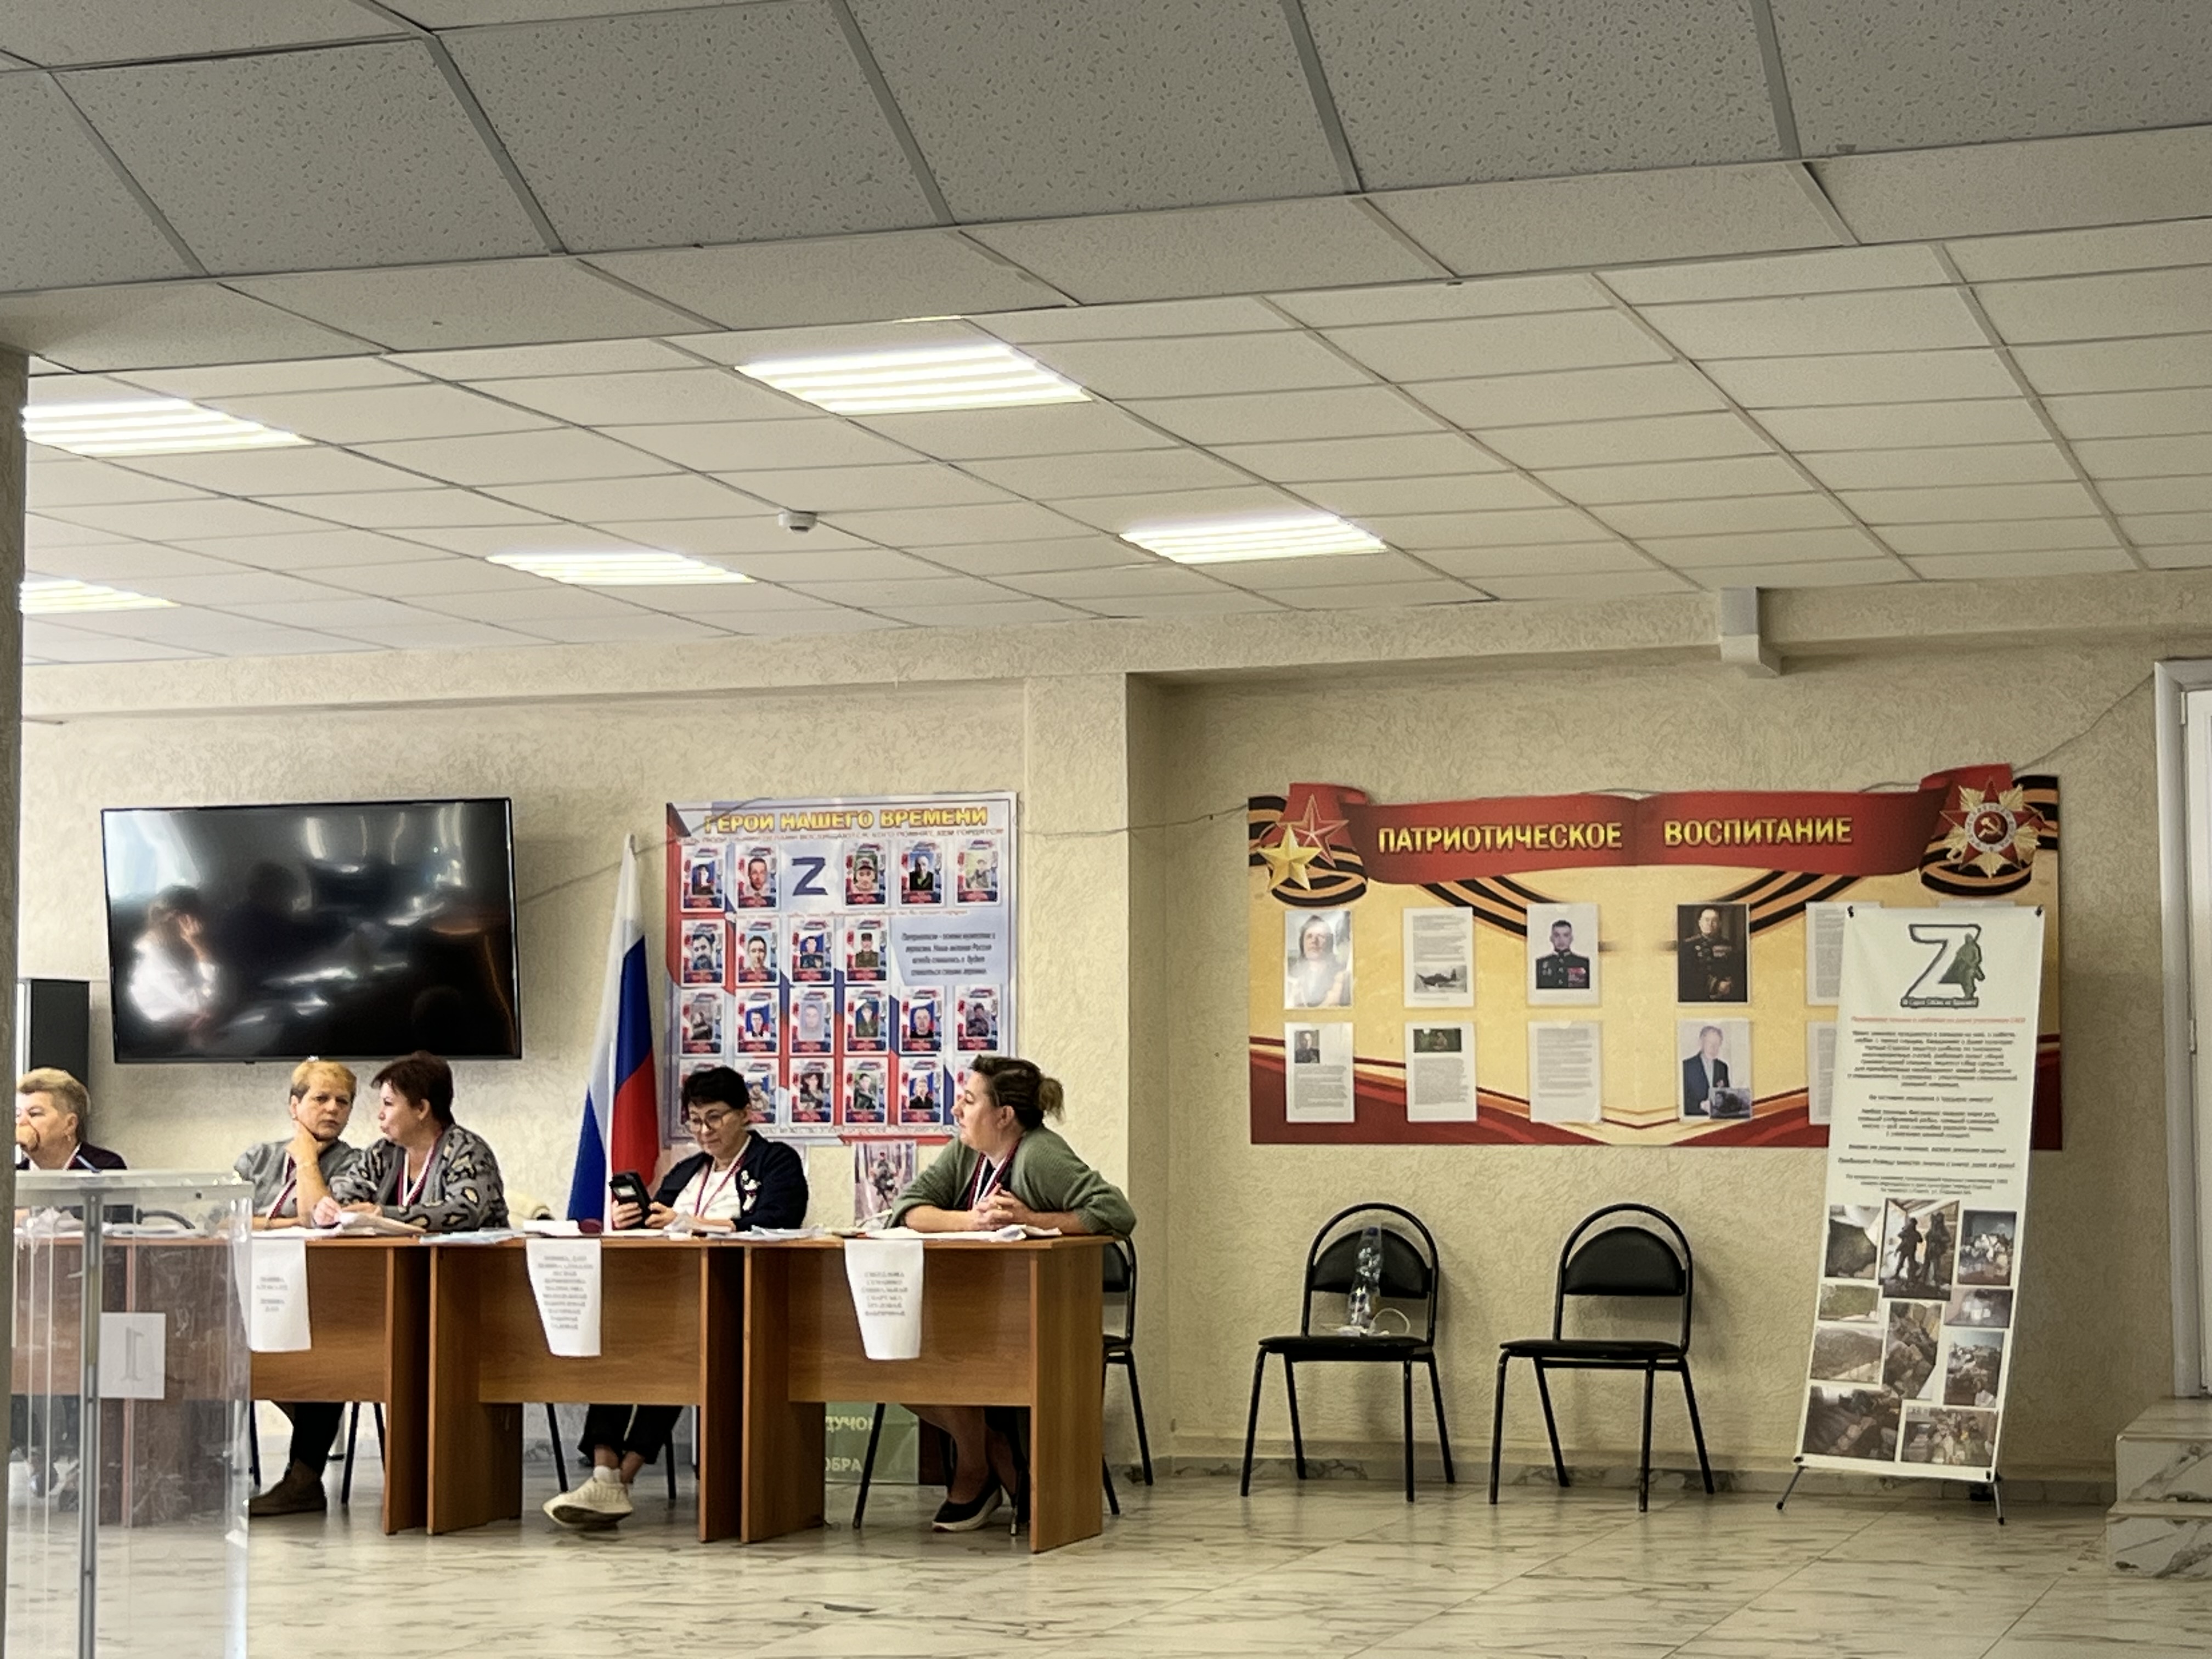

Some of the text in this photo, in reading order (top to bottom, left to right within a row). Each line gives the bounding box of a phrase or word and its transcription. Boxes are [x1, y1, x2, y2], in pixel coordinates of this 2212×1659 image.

[704, 807, 988, 833] ГЕРОИ НАШЕГО ВРЕМЕНИ
[1378, 816, 1853, 854] ПАТРИОТИЧЕСКОЕ ВОСПИТАНИЕ
[792, 857, 828, 896] Z
